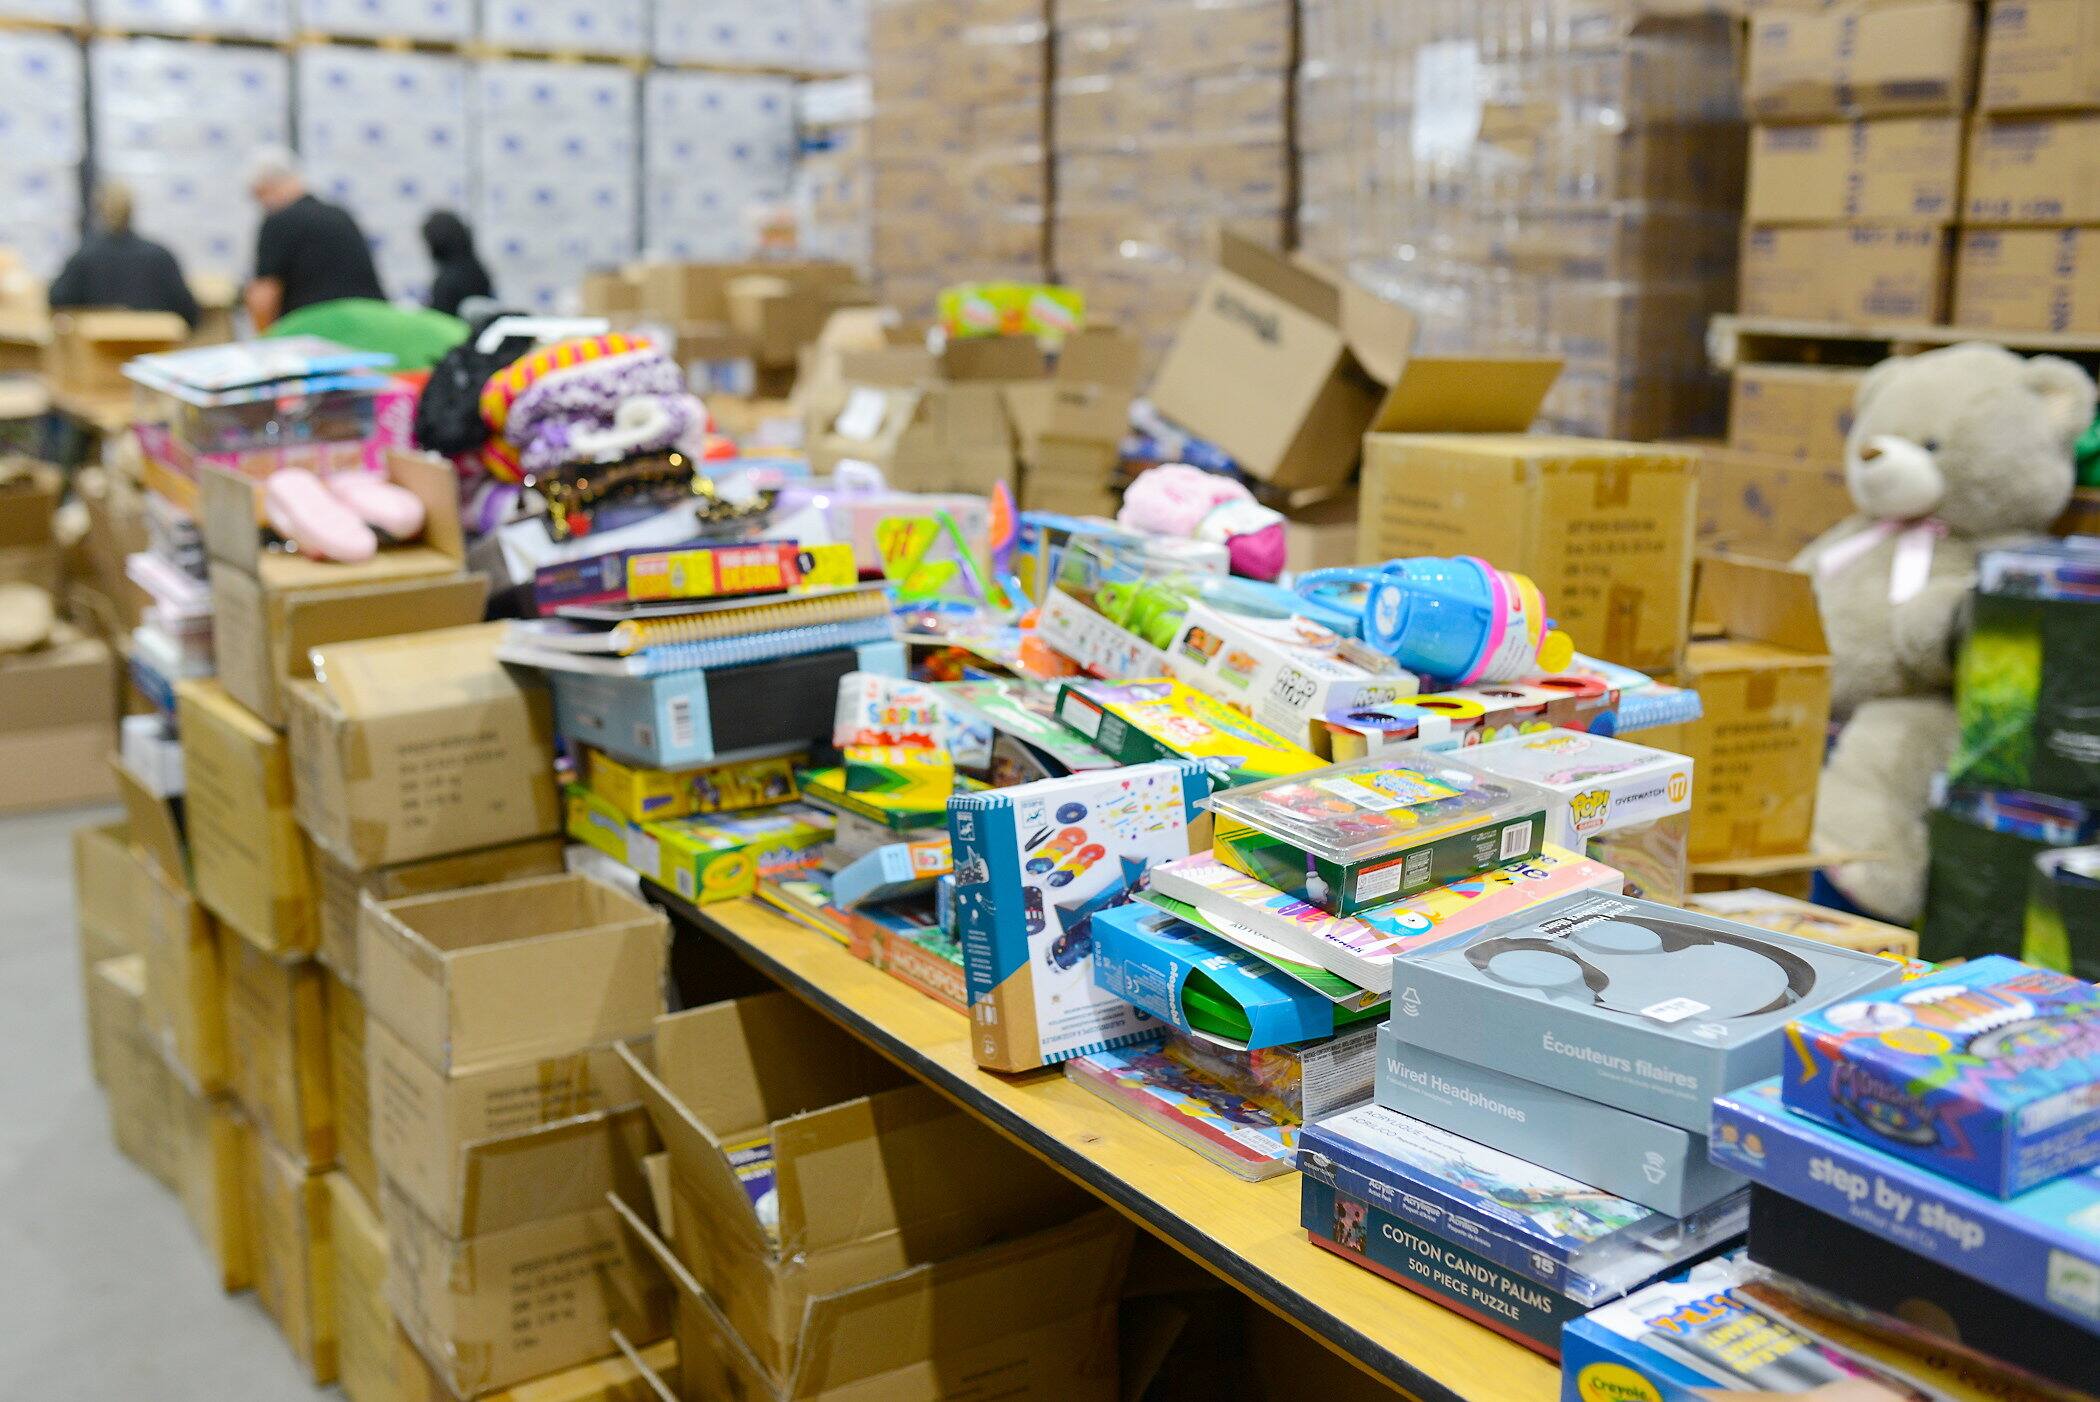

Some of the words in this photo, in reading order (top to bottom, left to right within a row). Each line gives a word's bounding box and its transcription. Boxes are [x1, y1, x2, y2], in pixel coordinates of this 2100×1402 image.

[1569, 789, 1611, 824] POP!
[1543, 1030, 1631, 1073] Écouteurs
[1636, 1059, 1698, 1090] filaires
[1387, 1057, 1428, 1085] Wired
[1431, 1075, 1526, 1123] Headphones
[1364, 1109, 1424, 1136] ACRYLIQUE
[1808, 1155, 1870, 1199] step
[1874, 1177, 1914, 1222] by
[1918, 1200, 1986, 1250] step
[1381, 1222, 1443, 1263] COTTON
[1444, 1250, 1500, 1288] CANDY
[1500, 1274, 1553, 1314] PALMS
[1408, 1257, 1431, 1279] 500
[1433, 1268, 1469, 1296] PIECE
[1472, 1284, 1521, 1321] PUZZLE
[1533, 1254, 1556, 1276] 15
[1648, 1294, 1745, 1334] LTRA
[1592, 1376, 1649, 1400] Crayola
